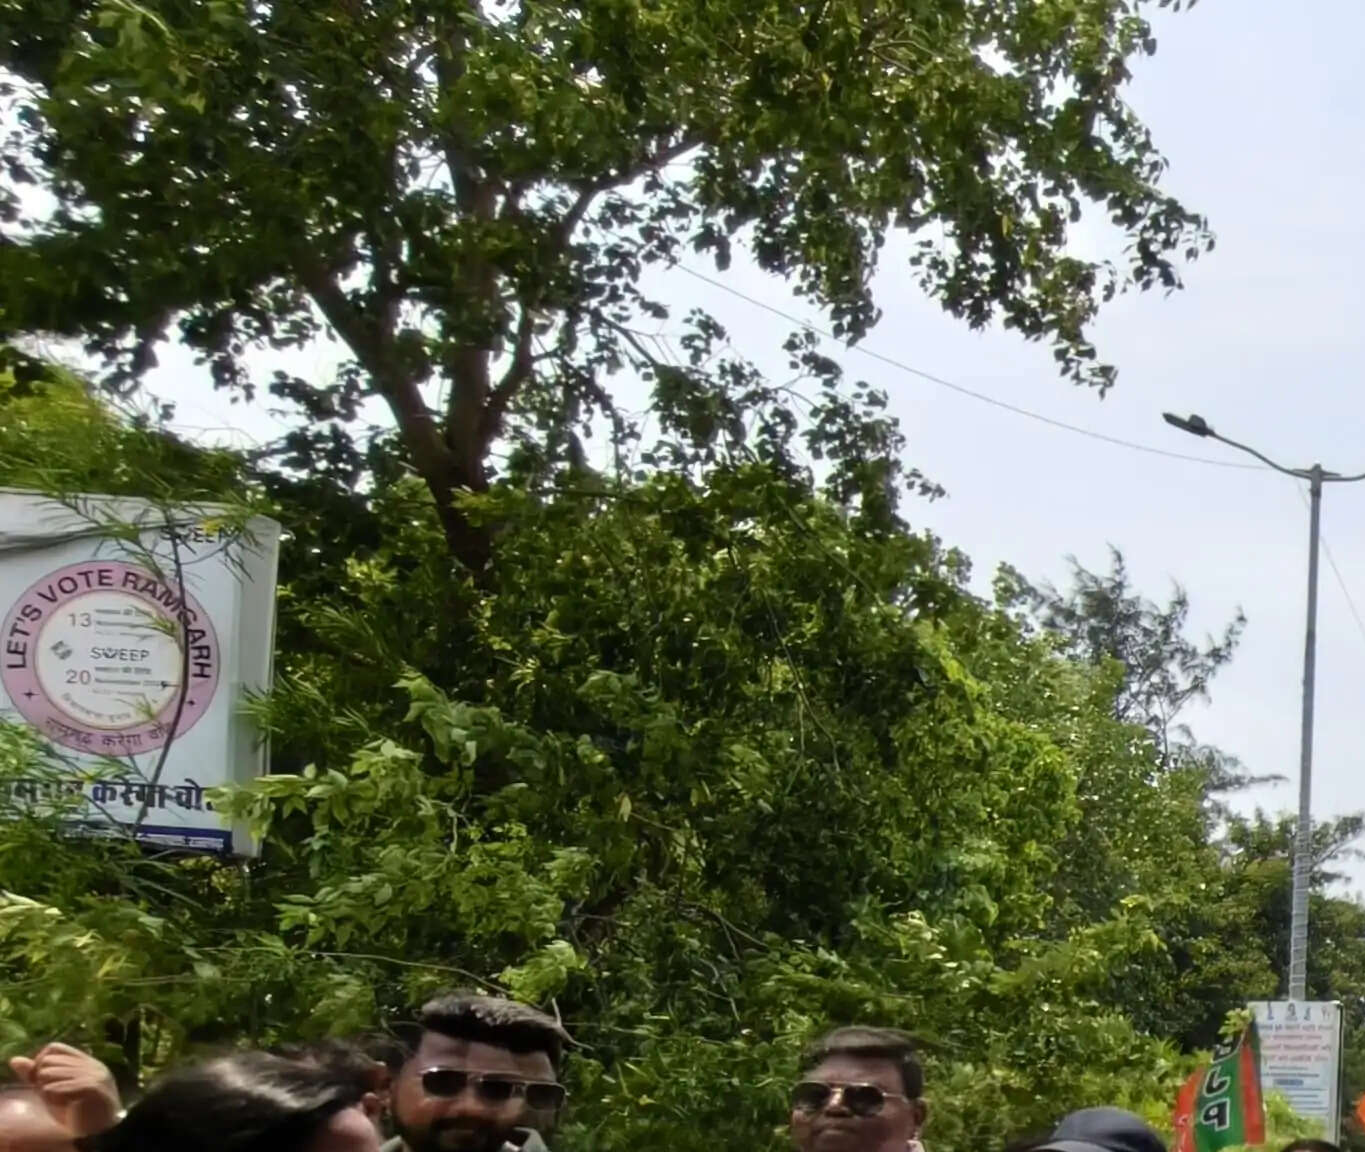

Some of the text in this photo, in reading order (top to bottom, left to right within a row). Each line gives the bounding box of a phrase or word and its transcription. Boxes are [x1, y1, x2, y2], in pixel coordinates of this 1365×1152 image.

[7, 569, 212, 679] LET'S VOTE RAMGARH
[69, 613, 93, 628] 13
[90, 648, 150, 662] SWEEP
[66, 669, 92, 686] 20
